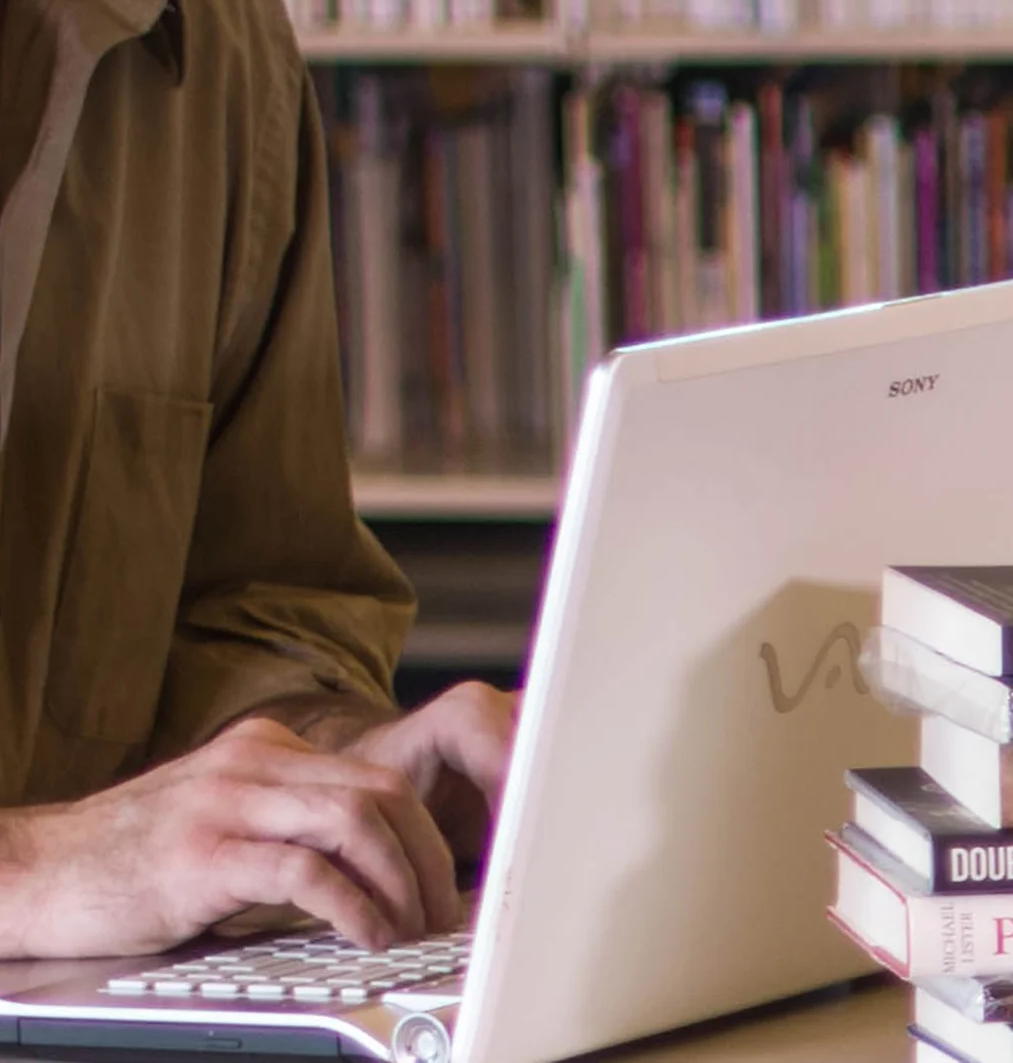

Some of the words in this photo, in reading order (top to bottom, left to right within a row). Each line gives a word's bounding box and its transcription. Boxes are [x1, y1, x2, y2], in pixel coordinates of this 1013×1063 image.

[888, 374, 940, 398] SONY
[940, 902, 956, 973] MICHAEL
[959, 912, 975, 964] LISTER
